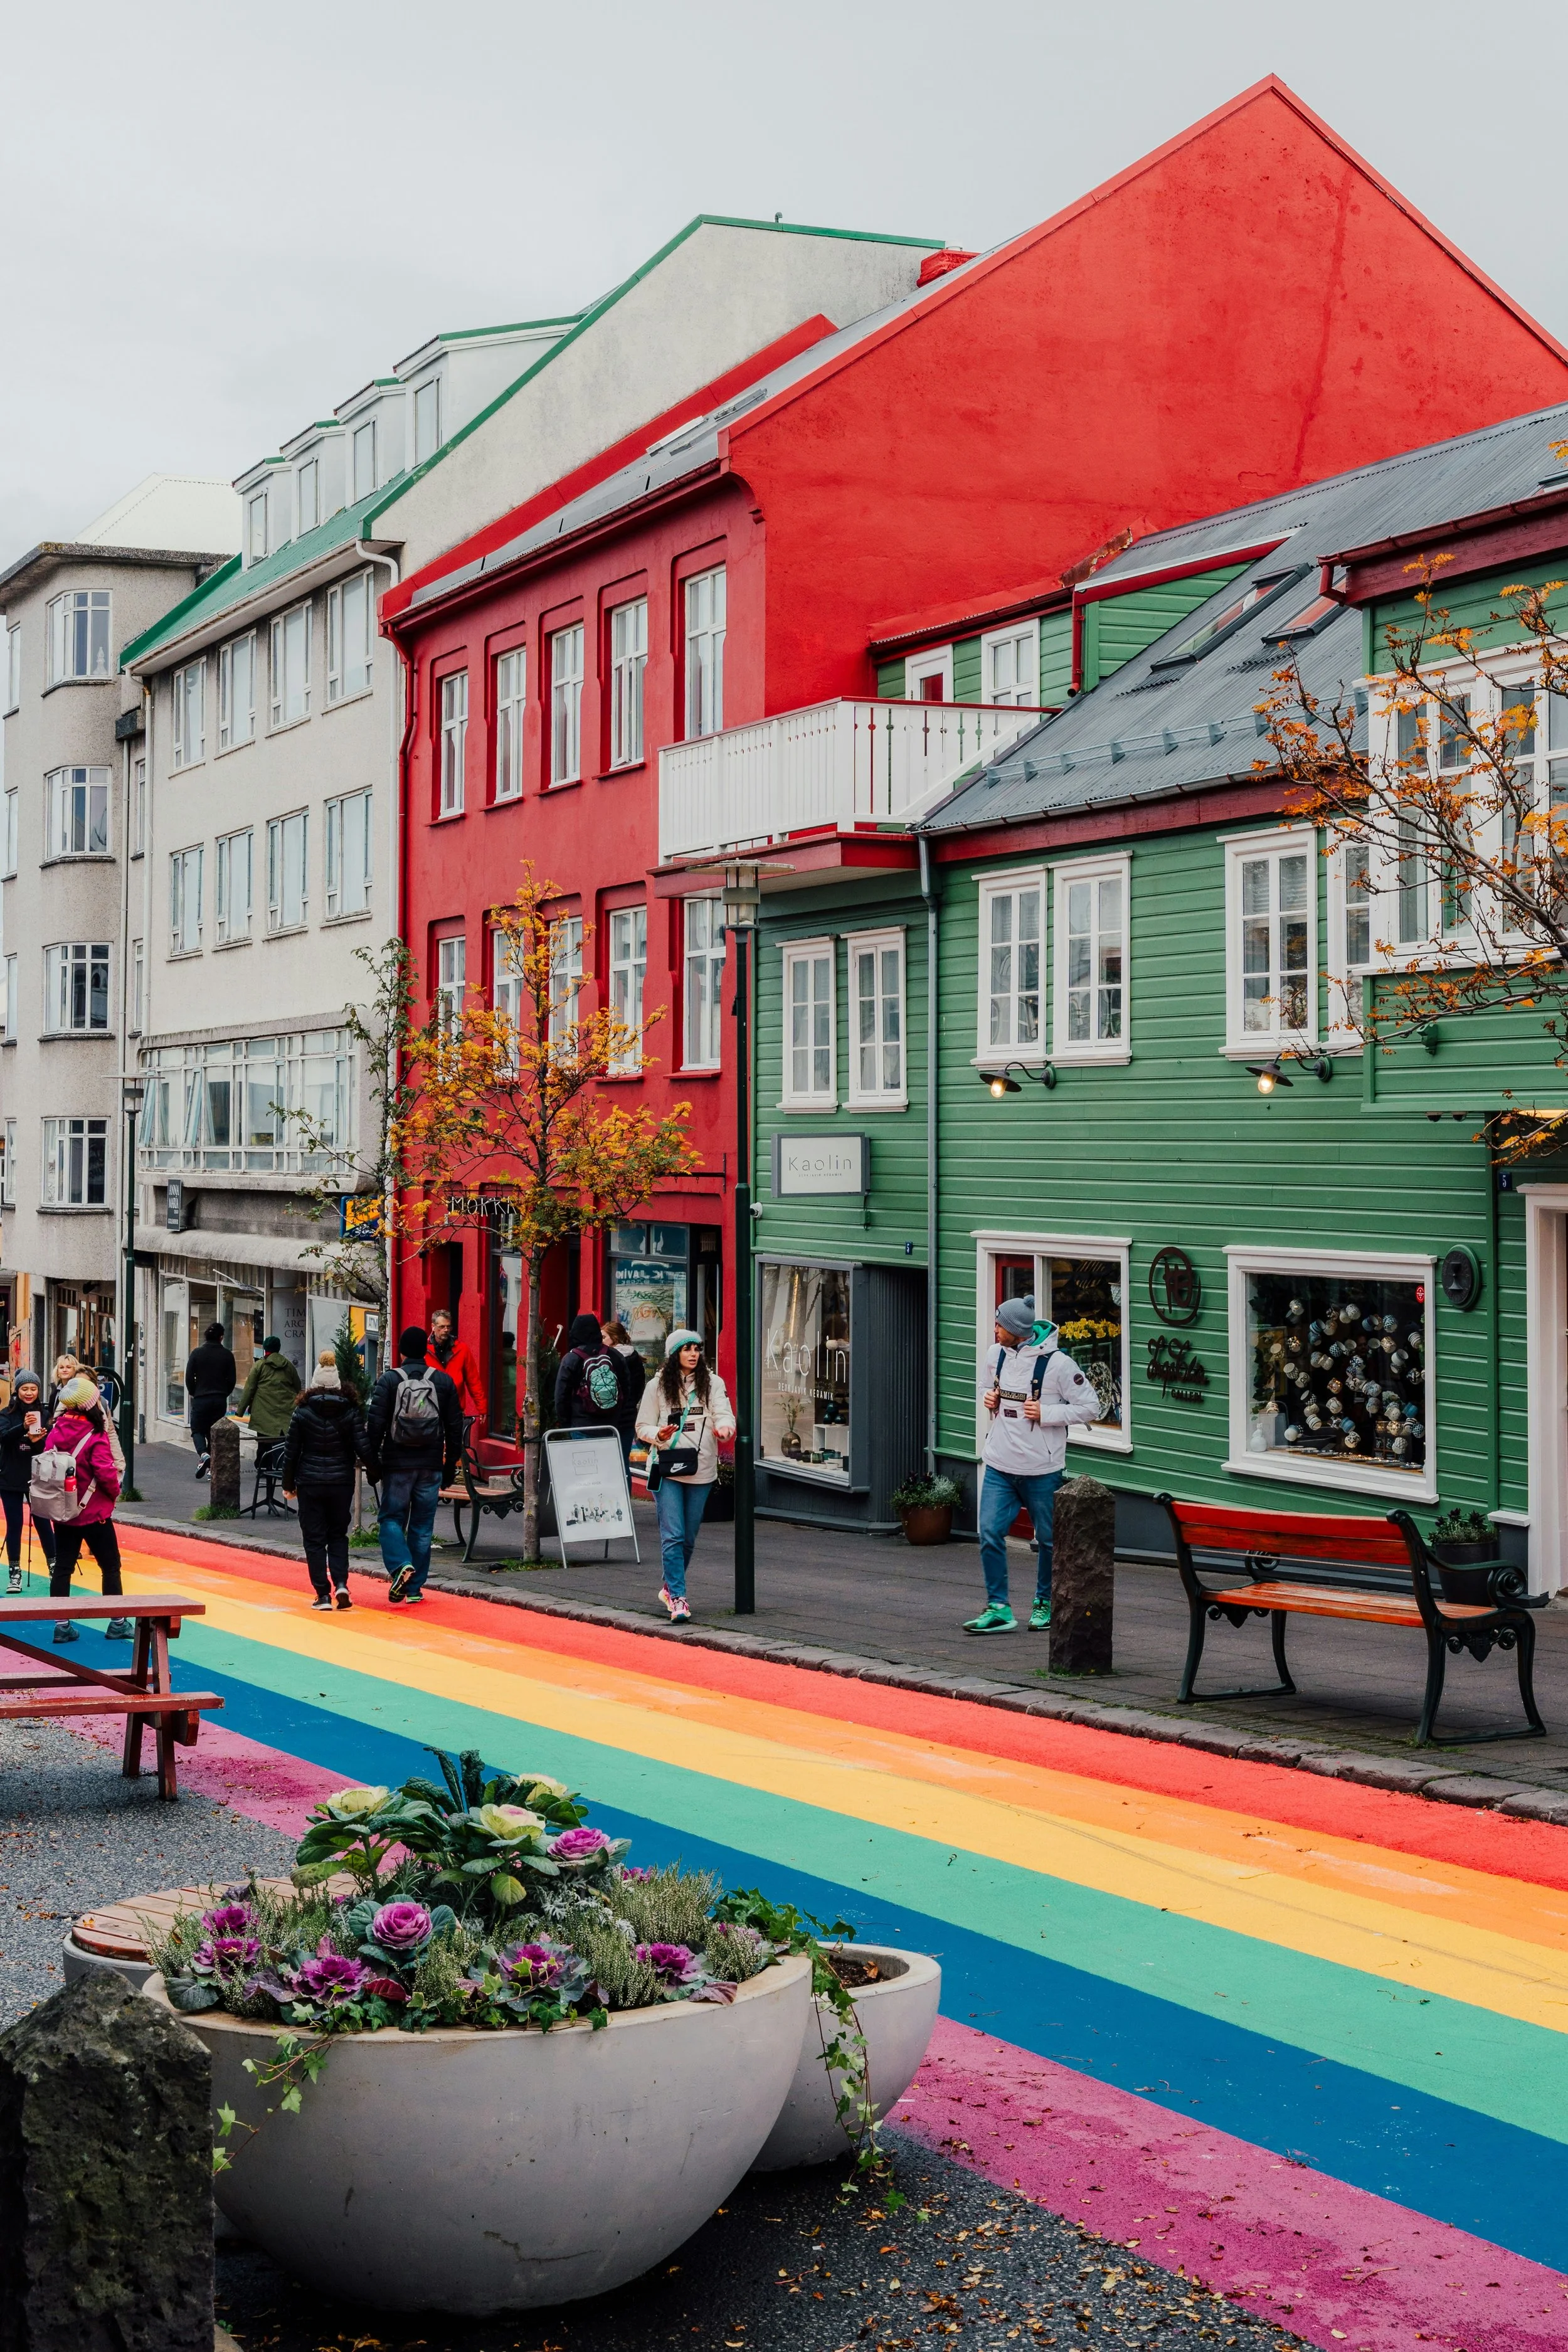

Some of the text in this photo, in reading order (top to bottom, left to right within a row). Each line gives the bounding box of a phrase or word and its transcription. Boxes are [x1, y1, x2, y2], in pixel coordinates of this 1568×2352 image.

[789, 1154, 851, 1171] Kaolin
[1502, 1175, 1507, 1187] 5
[169, 1184, 179, 1195] ANNA
[284, 1320, 306, 1328] ARC
[767, 1328, 846, 1383] Kaolin
[778, 1382, 834, 1401] REYKJAVIK KERAMIK
[571, 1458, 599, 1466] Kaolin
